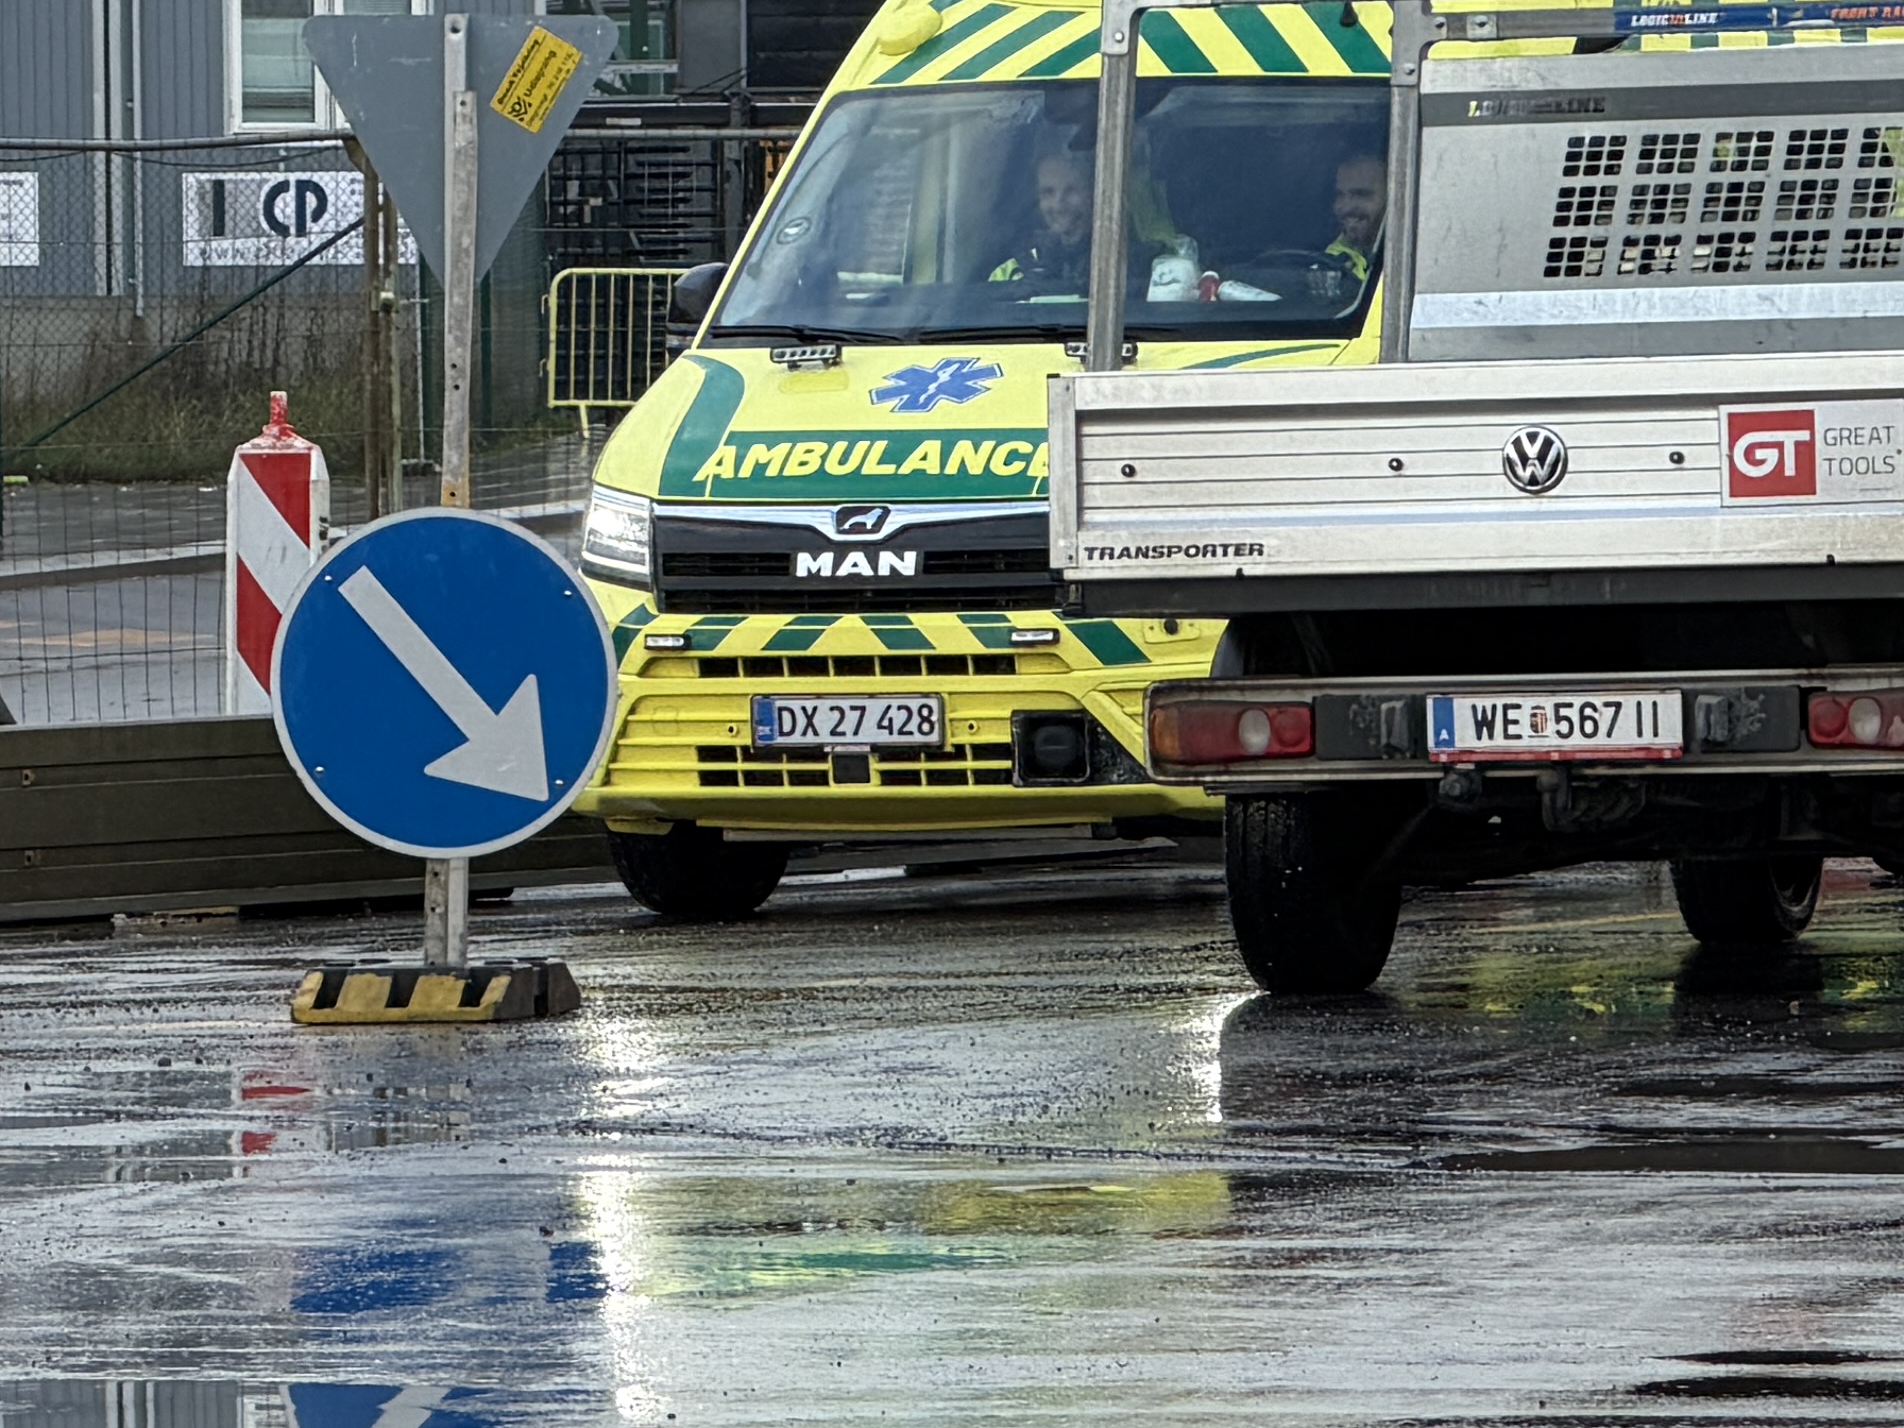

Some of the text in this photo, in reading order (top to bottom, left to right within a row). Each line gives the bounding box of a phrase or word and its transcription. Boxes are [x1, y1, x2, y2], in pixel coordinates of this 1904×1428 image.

[1823, 425, 1895, 446] GREAT
[1733, 430, 1811, 478] GT
[1823, 456, 1896, 477] TOOLS
[796, 550, 917, 577] MAN
[1084, 543, 1265, 560] TRANSPORTER
[777, 703, 935, 737] DX 27 428
[1471, 703, 1523, 741] WE
